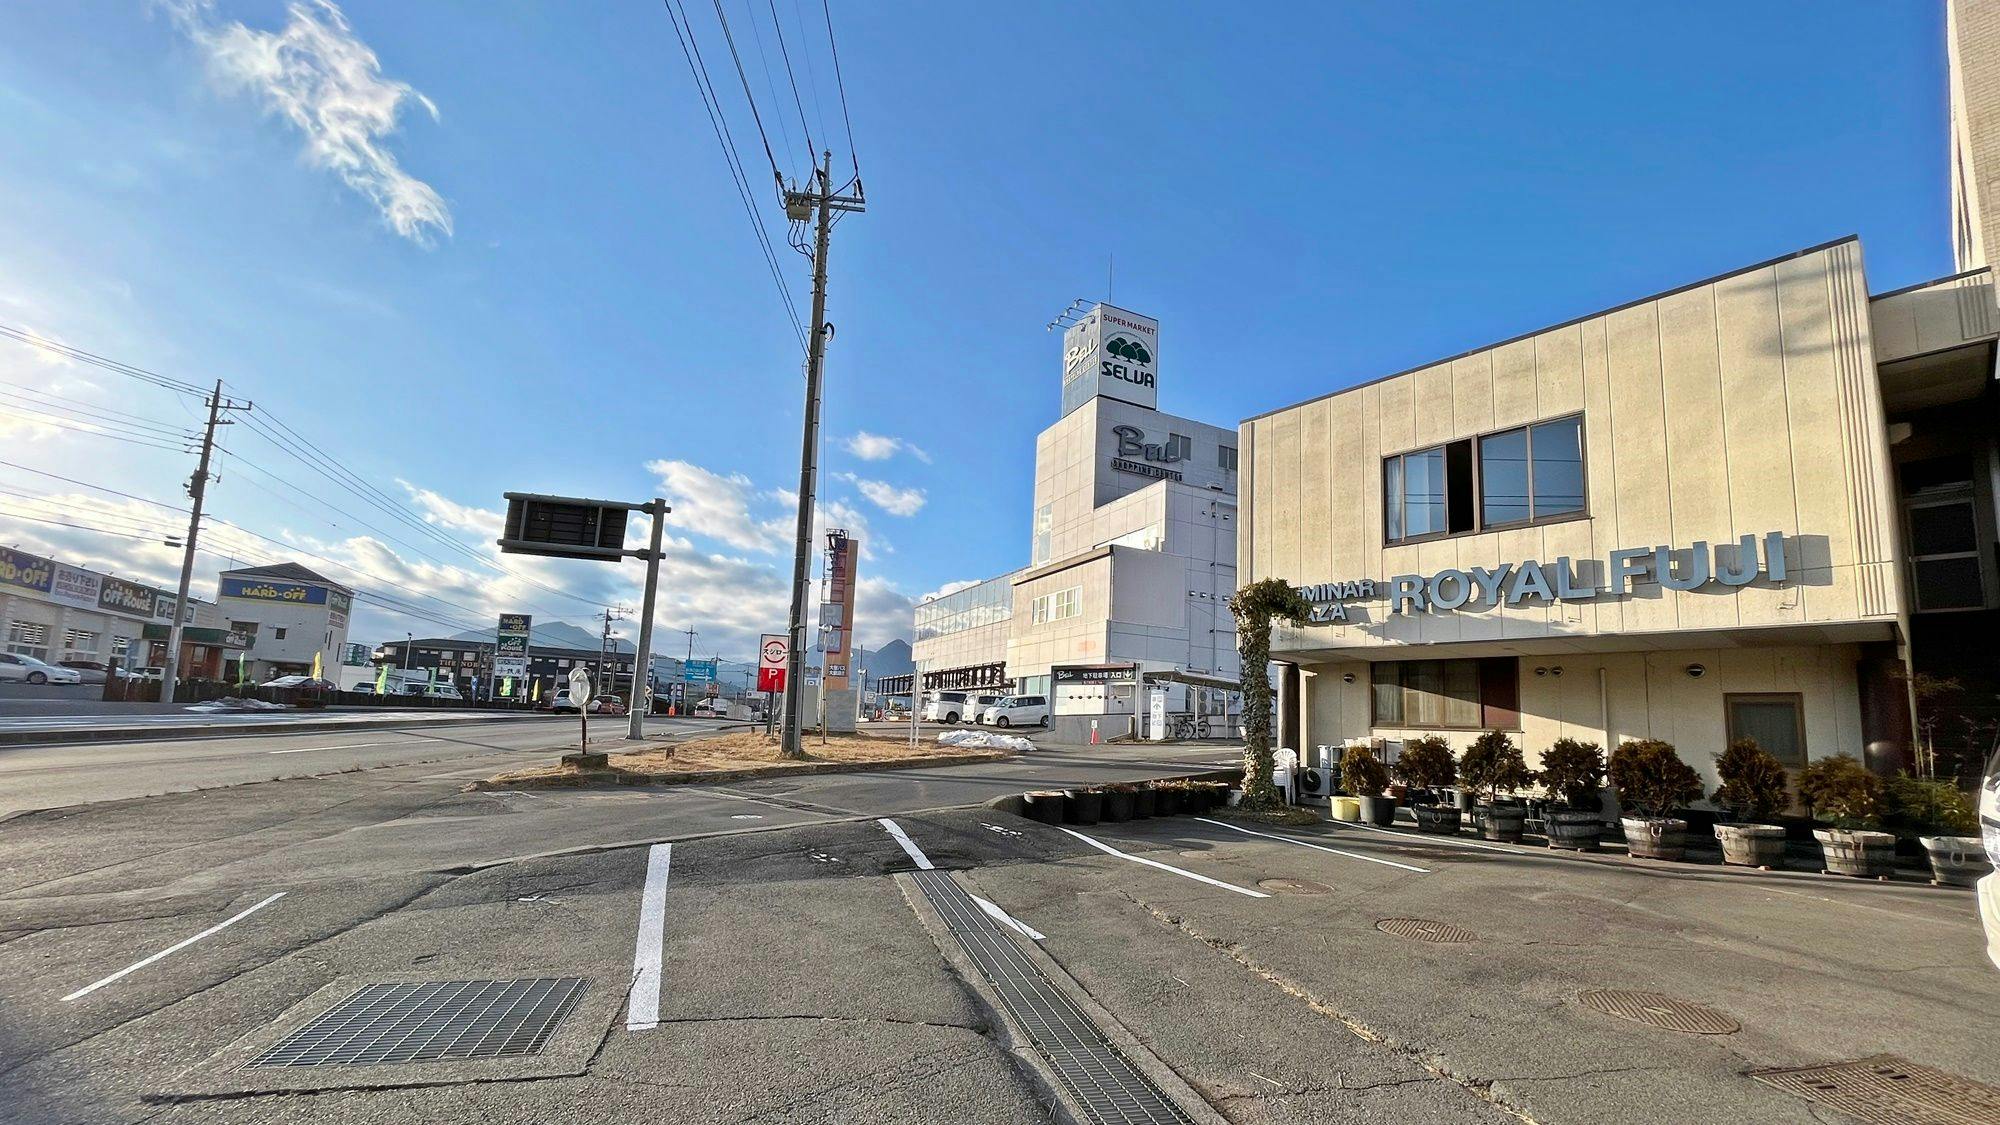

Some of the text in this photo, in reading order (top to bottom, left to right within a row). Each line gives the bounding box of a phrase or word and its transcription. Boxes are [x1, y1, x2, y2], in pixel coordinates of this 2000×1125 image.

[1103, 314, 1155, 335] SUPERMARKET
[1101, 361, 1155, 389] SELVA
[1111, 459, 1152, 475] SHOPPING
[1390, 531, 1787, 614] ROYAL FUJI
[103, 589, 123, 604] OFF
[1297, 579, 1375, 602] MINAR
[1308, 602, 1347, 622] AZA
[768, 669, 778, 679] P
[1110, 671, 1122, 679] 入口
